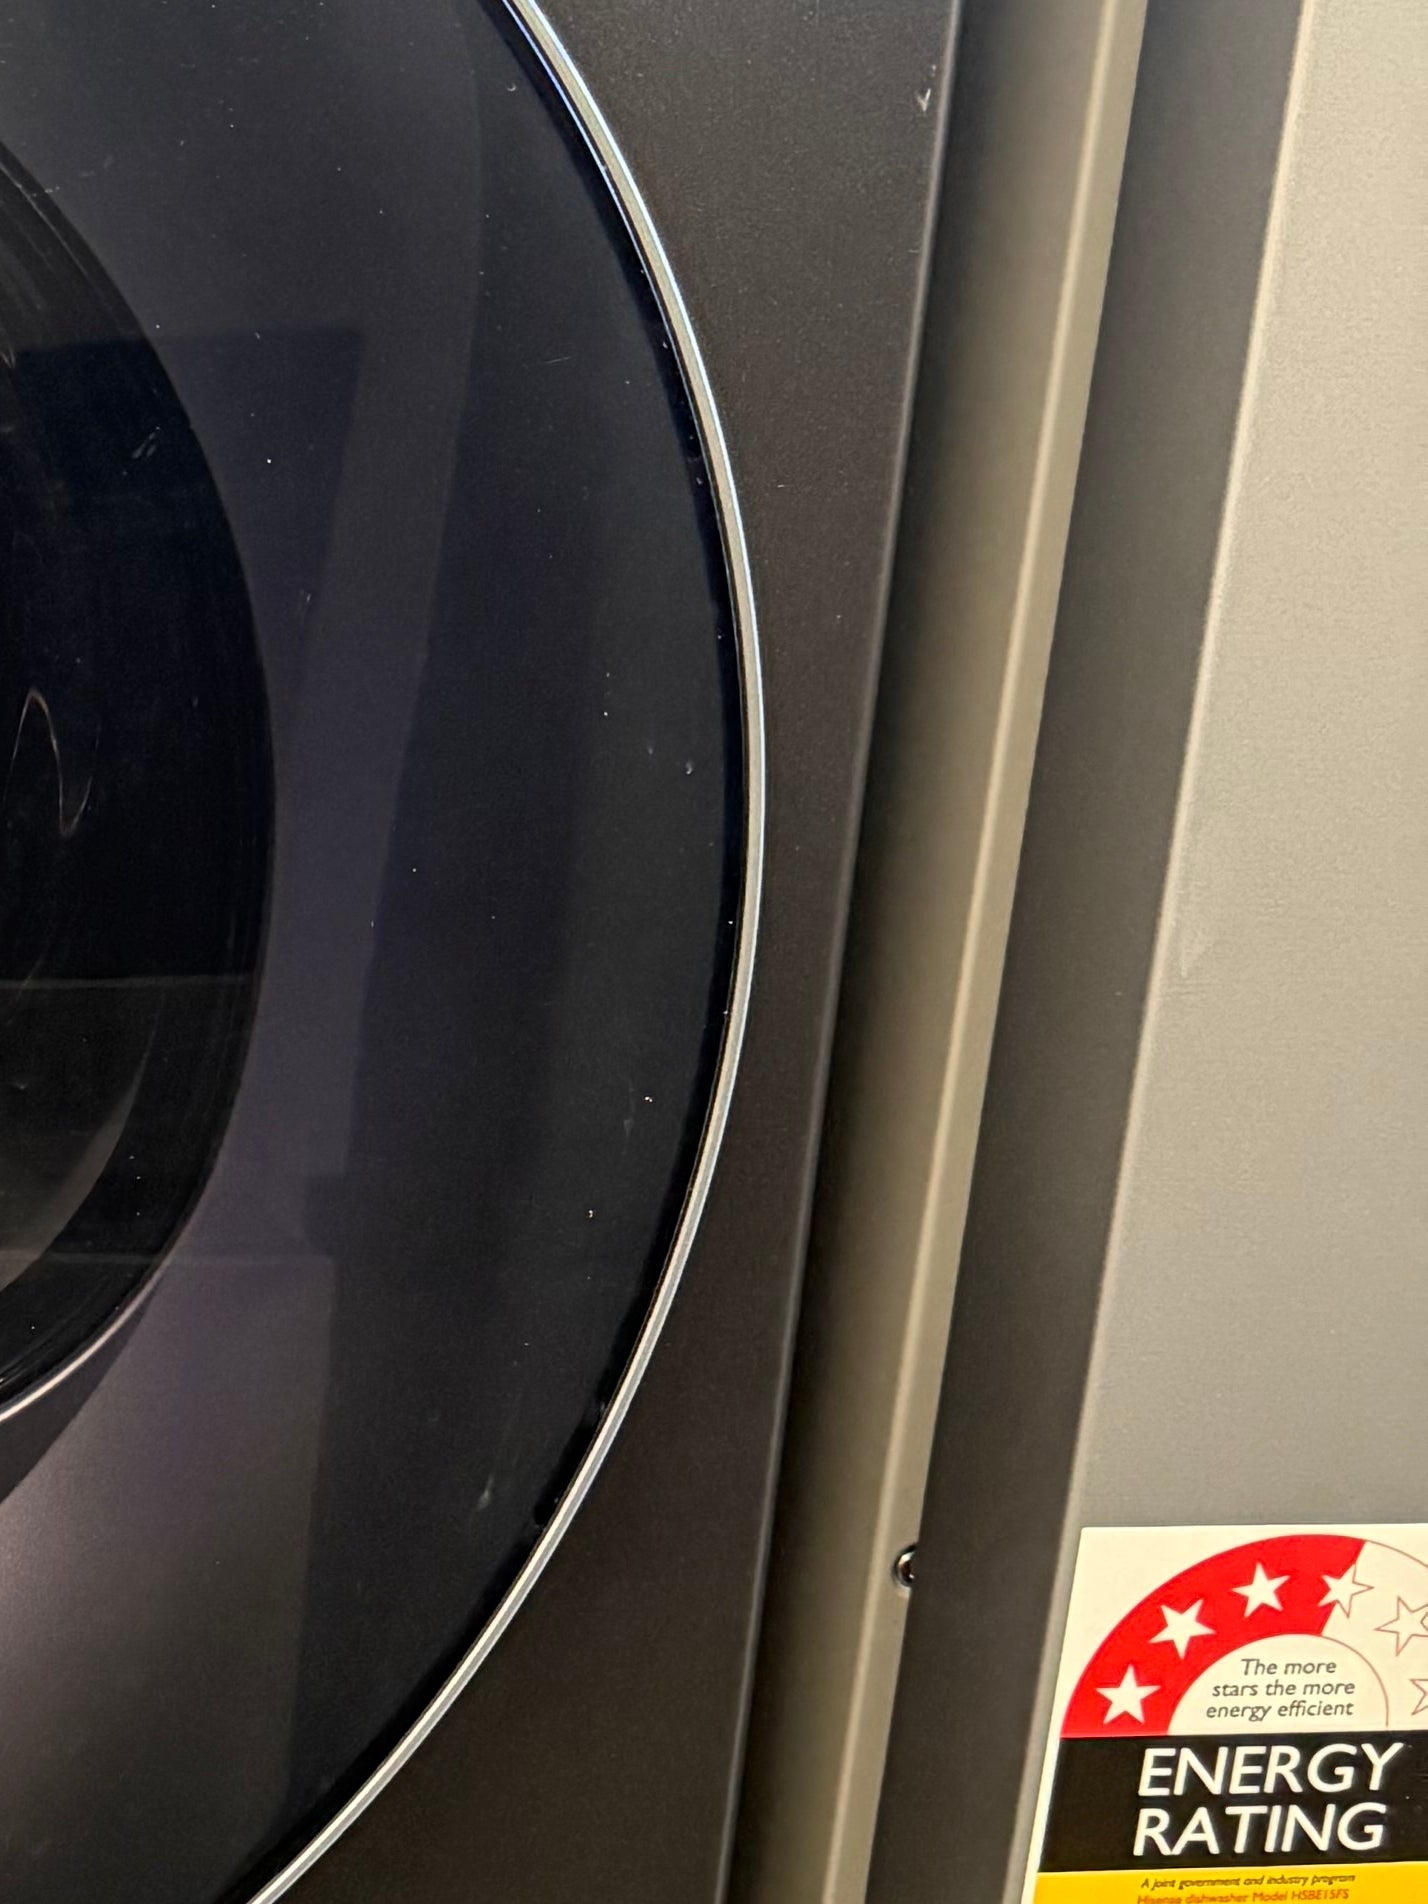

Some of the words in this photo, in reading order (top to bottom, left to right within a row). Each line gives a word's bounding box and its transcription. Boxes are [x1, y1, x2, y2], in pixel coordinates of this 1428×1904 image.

[1241, 1658, 1278, 1676] The
[1283, 1661, 1337, 1675] more
[1212, 1681, 1258, 1698] stars
[1264, 1680, 1296, 1697] the
[1300, 1682, 1355, 1696] more
[1206, 1703, 1271, 1721] energy
[1277, 1700, 1354, 1717] efficient
[1137, 1742, 1405, 1797] ENERGY
[1133, 1802, 1387, 1856] RATING
